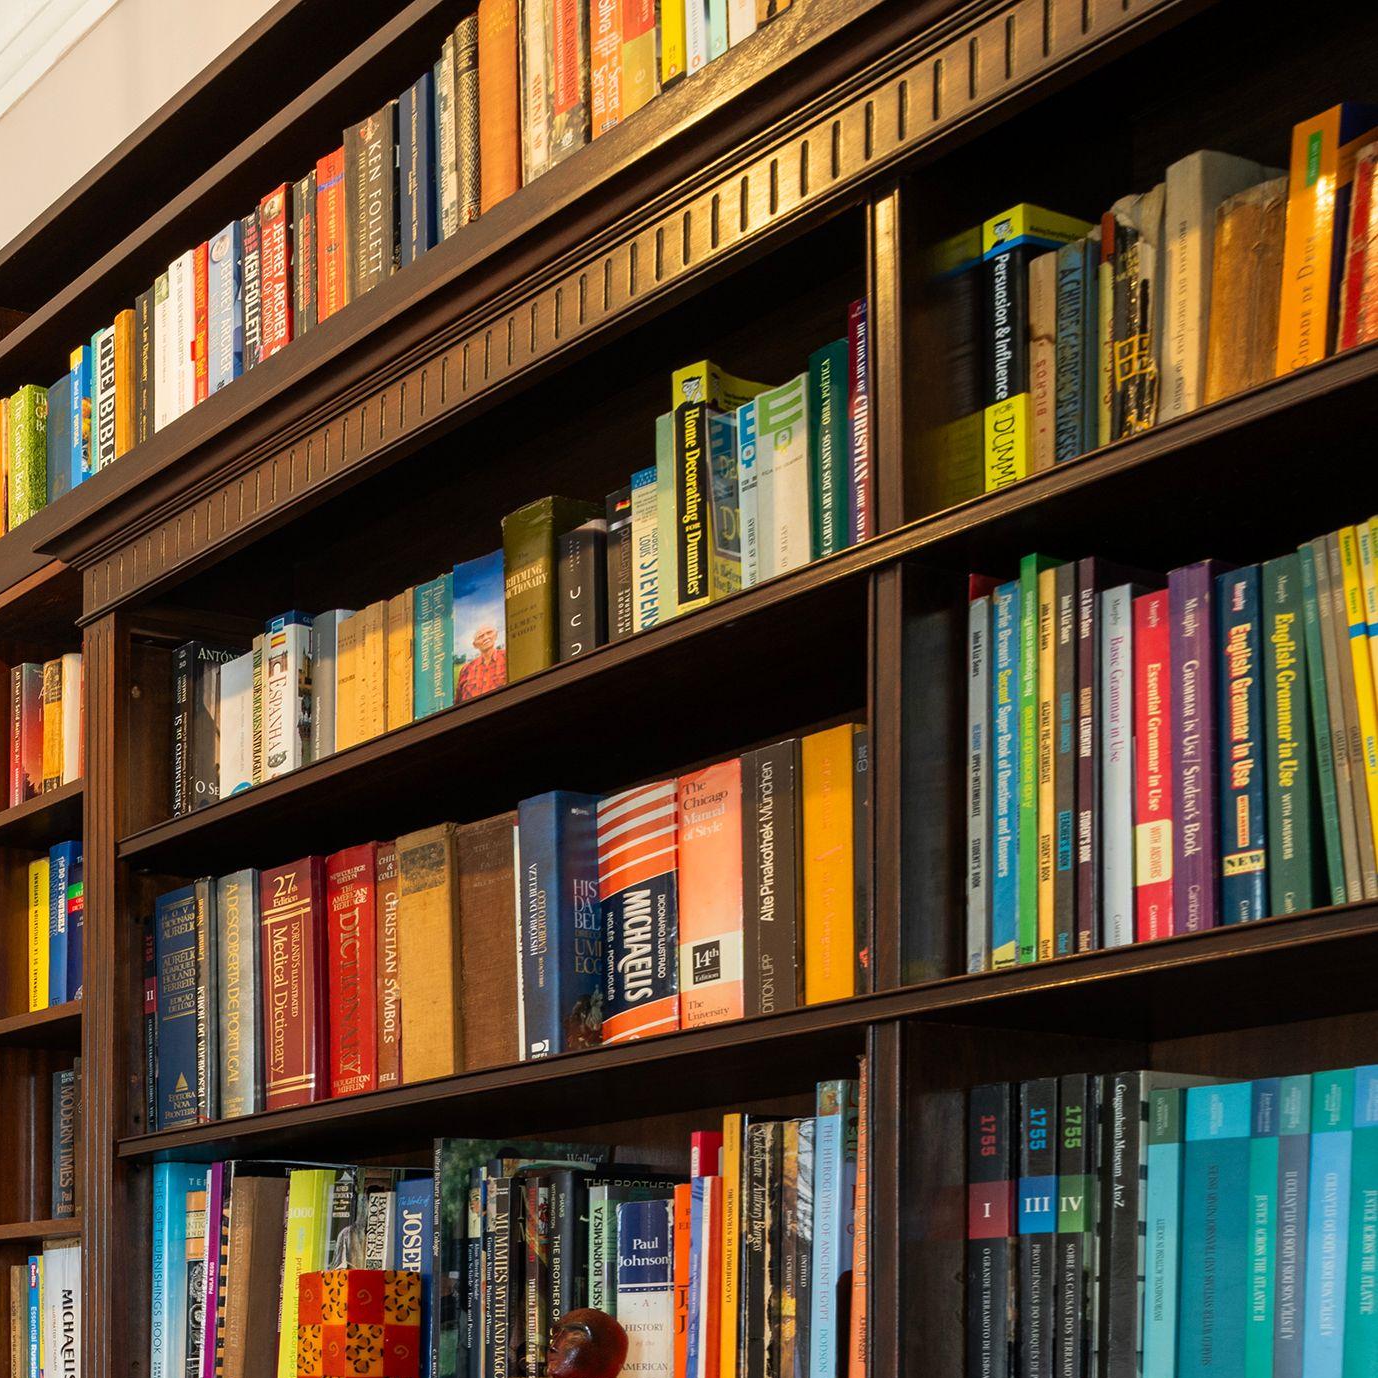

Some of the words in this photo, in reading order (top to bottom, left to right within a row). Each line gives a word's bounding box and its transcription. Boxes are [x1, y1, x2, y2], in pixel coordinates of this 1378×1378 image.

[369, 140, 382, 182] KEN
[273, 221, 285, 279] JEFFREY
[369, 188, 383, 275] FOLLETT
[220, 258, 233, 314] JEFFREY
[244, 252, 259, 280] KEN
[244, 280, 260, 347] FOLLETT
[273, 283, 286, 341] ARCHER
[100, 333, 115, 396] THE
[220, 318, 233, 377] ARCHER
[821, 357, 831, 399] POÉTICA
[98, 393, 115, 468] BIBLE
[684, 407, 701, 448] Home
[821, 400, 831, 425] OBRA
[15, 418, 27, 467] Garden
[821, 434, 832, 468] SANTOS
[854, 394, 868, 483] CHRISTIAN
[682, 446, 702, 524] Decorating
[822, 468, 832, 489] DOS
[822, 490, 832, 512] ARY
[822, 513, 833, 548] CARLOS
[422, 620, 432, 673] Dickinson
[1224, 623, 1253, 679] English
[1270, 612, 1297, 669] English
[998, 668, 1012, 705] Second
[1109, 666, 1125, 725] Grammar
[1147, 662, 1162, 715] Essential
[1228, 677, 1254, 743] Grammar
[1275, 669, 1297, 741] Grammar
[269, 675, 287, 754] ESPANHA
[1147, 715, 1162, 774] Grammar
[173, 740, 183, 810] SENTIMENTO
[683, 780, 707, 797] The
[758, 761, 775, 823] München
[1230, 759, 1254, 790] Use
[1278, 759, 1299, 788] Use
[683, 788, 729, 812] Chicago
[683, 802, 726, 827] Manual
[694, 820, 724, 841] Style
[759, 823, 775, 895] Pinakothek
[997, 836, 1012, 879] Answers
[574, 895, 594, 913] DA
[760, 895, 775, 922] Alte
[226, 897, 240, 989] DESCOBERTA
[291, 920, 301, 969] DORLAND'S
[384, 891, 398, 974] CHRISTIAN
[617, 889, 654, 1004] MICHAELIS
[272, 925, 290, 990] Medical
[694, 947, 720, 969] 14th
[291, 968, 300, 1018] ILLUSTRATED
[338, 907, 362, 1075] DICTIONARY
[384, 978, 398, 1045] SYMBOLS
[687, 1007, 731, 1022] University
[226, 1010, 241, 1088] PORTUGAL
[271, 991, 290, 1075] Dictionary
[60, 1084, 74, 1146] MODERN
[980, 1114, 997, 1157] 1755
[1029, 1107, 1047, 1151] 1755
[1063, 1105, 1082, 1150] 1755
[59, 1147, 73, 1189] TIMES
[821, 1146, 832, 1215] HIEROGLYPHS
[1113, 1139, 1126, 1177] Museum
[366, 1194, 380, 1258] SOURCES
[1023, 1196, 1052, 1214] III
[1059, 1195, 1085, 1213] IV
[494, 1212, 509, 1283] MUMMIES
[592, 1206, 605, 1277] BORNEMISZA
[619, 1254, 670, 1269] Johnson
[632, 1237, 659, 1251] Paul
[820, 1238, 830, 1285] ANCIENT
[152, 1231, 164, 1317] FURNISHINGS
[552, 1253, 561, 1302] BROTHER
[494, 1283, 508, 1319] MYTH
[152, 1317, 163, 1354] BOOK
[624, 1322, 665, 1334] HISTORY
